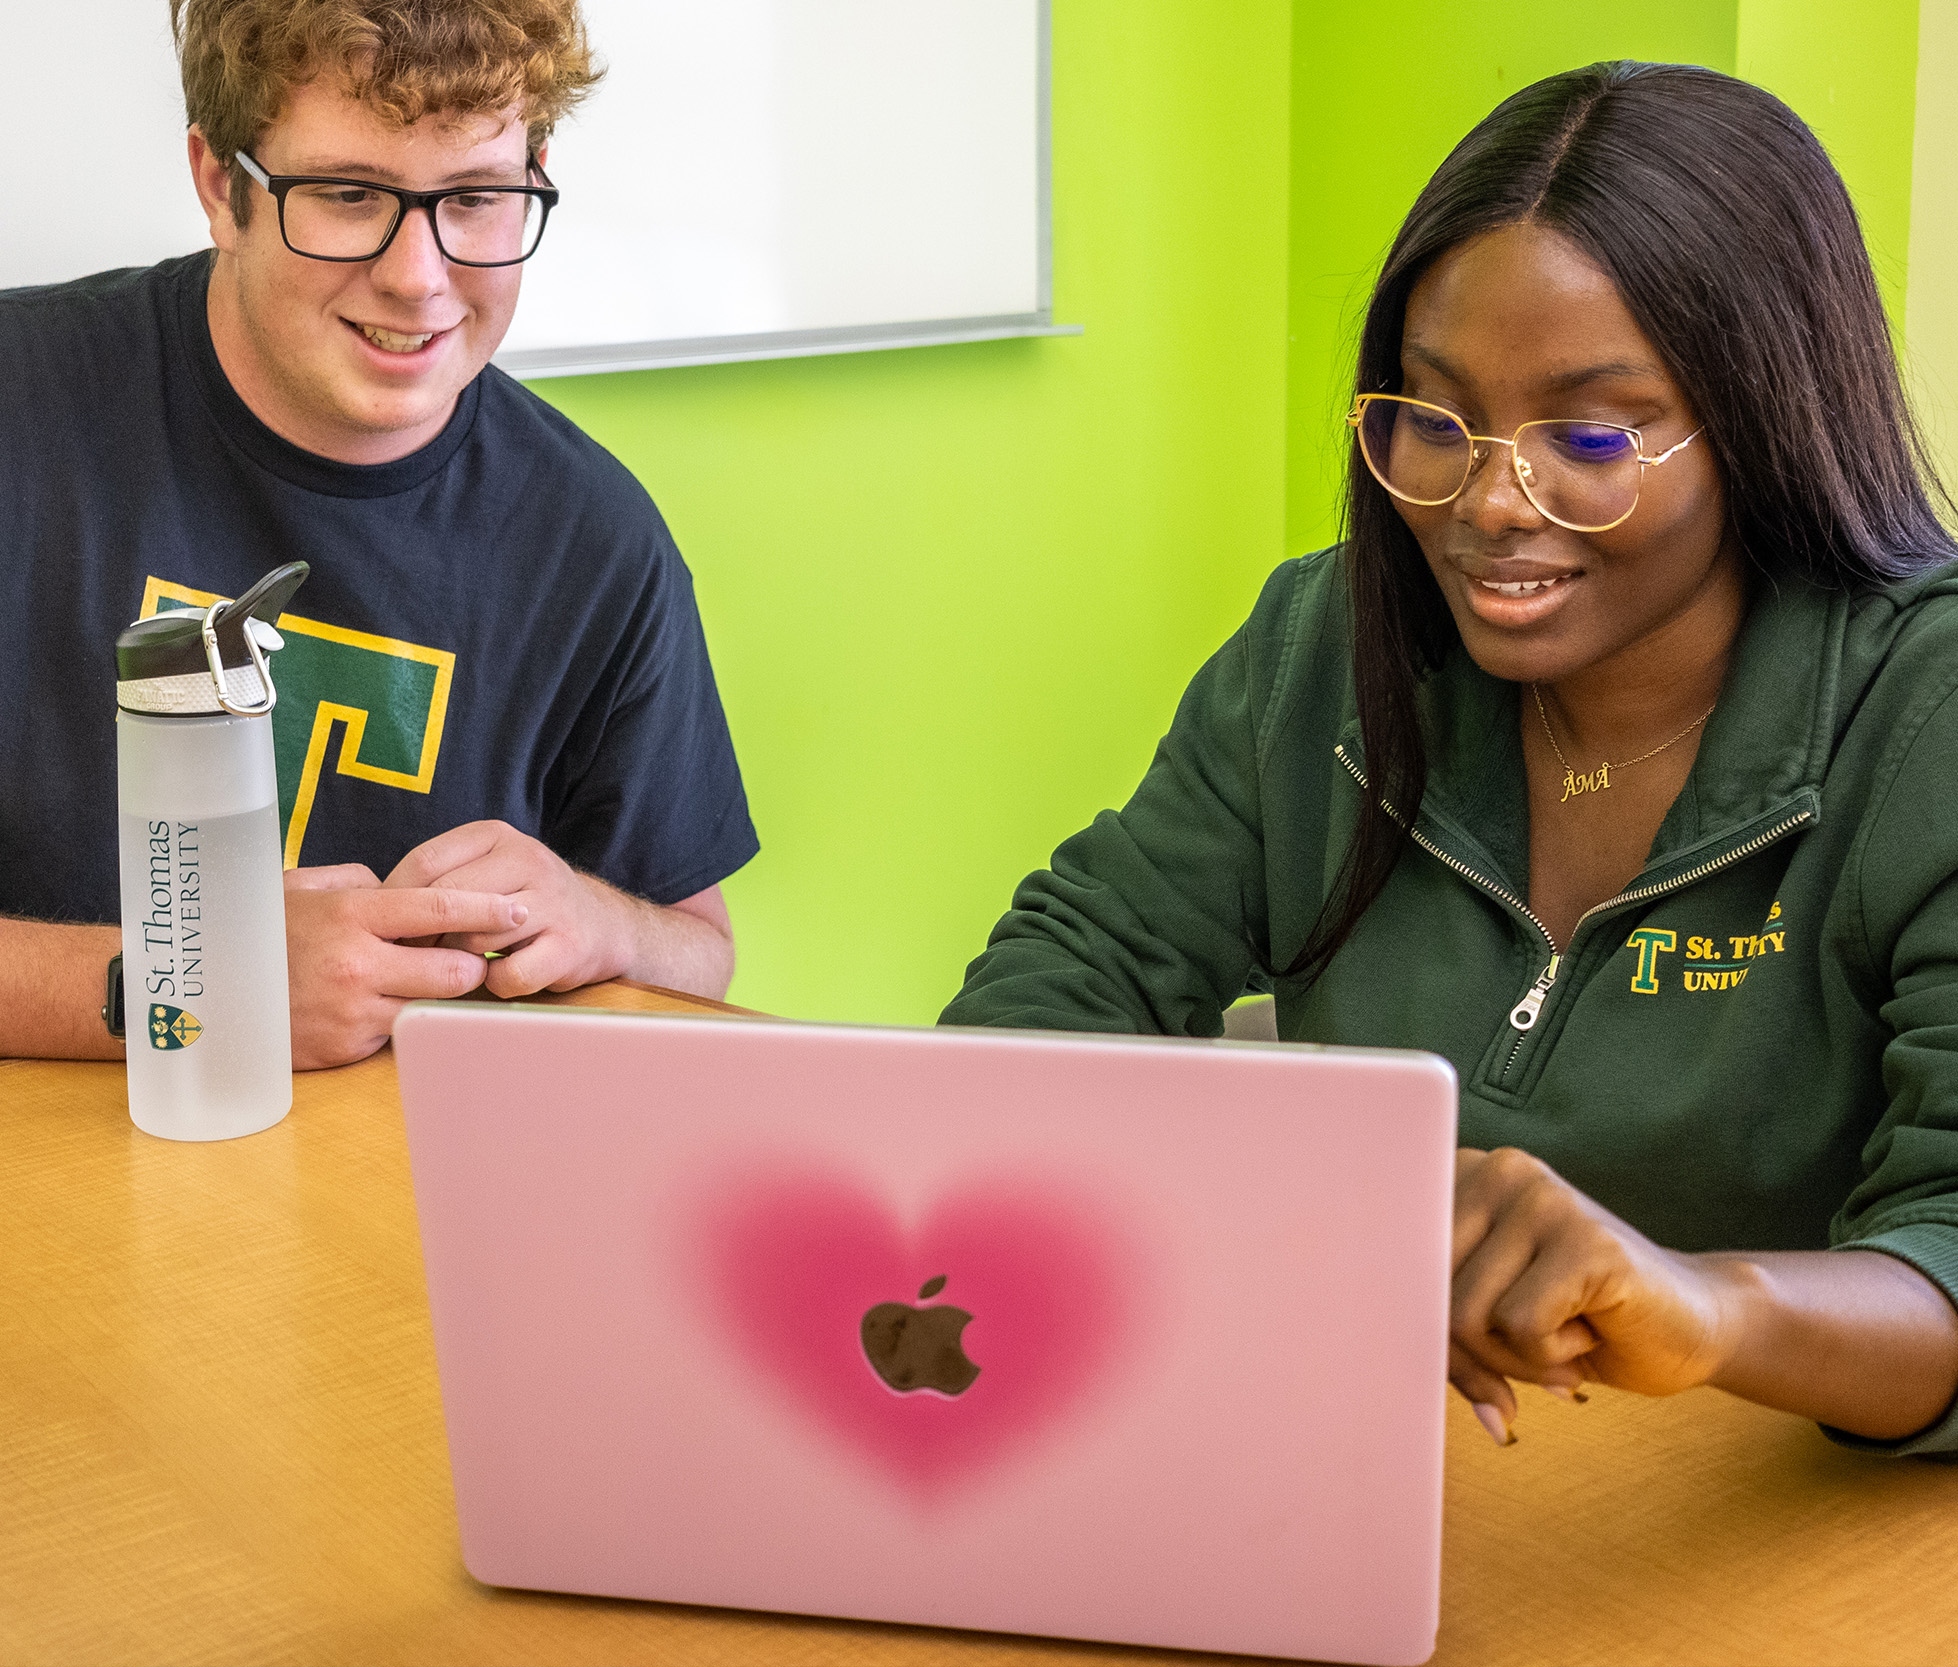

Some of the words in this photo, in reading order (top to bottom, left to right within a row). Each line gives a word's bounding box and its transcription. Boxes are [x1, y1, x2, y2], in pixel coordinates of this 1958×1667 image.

[136, 688, 186, 704] FANATIC
[146, 702, 174, 711] GROUP
[1560, 764, 1611, 802] AMA
[142, 820, 174, 953] Thomas
[177, 821, 204, 998] UNIVERSITY
[1626, 927, 1677, 995] T
[1685, 935, 1722, 960] St.
[145, 957, 176, 997] St.
[1683, 967, 1750, 992] UNIV
